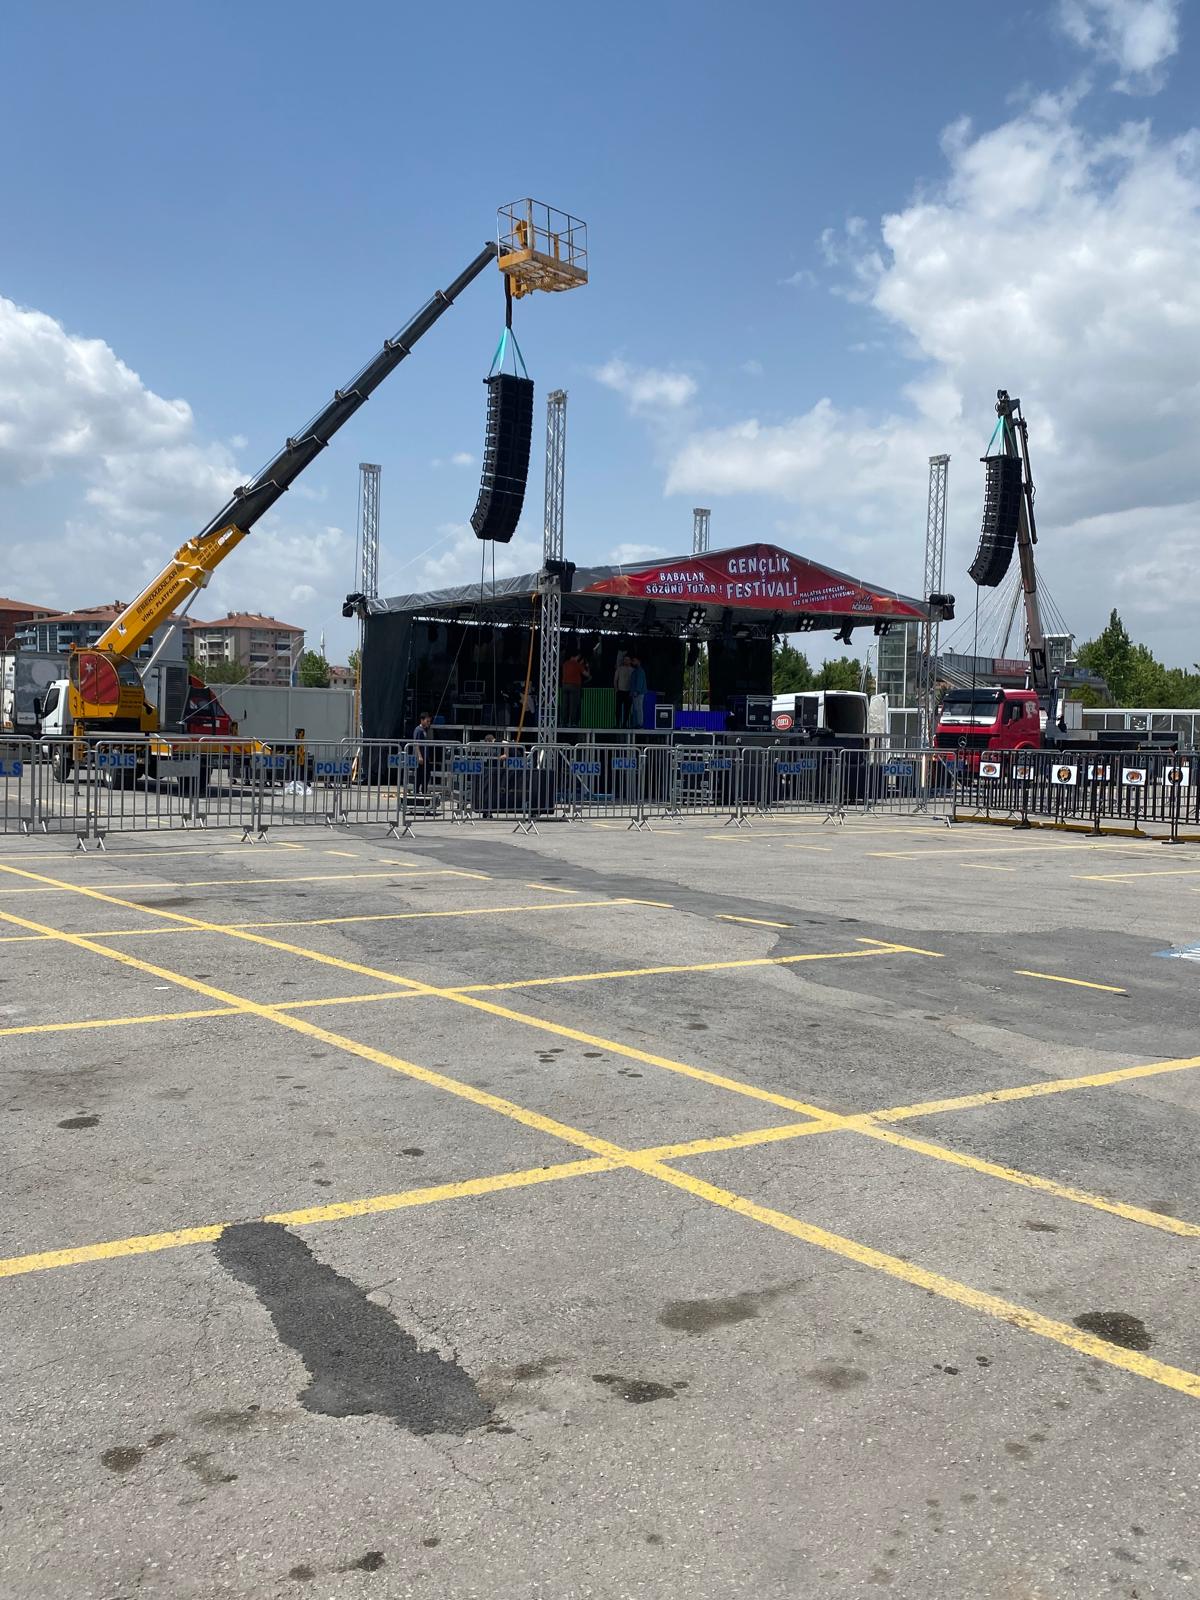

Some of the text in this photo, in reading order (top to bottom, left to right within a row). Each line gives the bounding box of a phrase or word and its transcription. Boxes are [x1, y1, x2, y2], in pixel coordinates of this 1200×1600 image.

[728, 553, 790, 576] GENÇLİK
[645, 582, 683, 594] SÖZÜNÜ
[687, 583, 716, 594] TUTAR
[660, 571, 705, 582] BABALAR
[726, 576, 798, 600] FESTİVALİ
[155, 580, 180, 608] PLATFORM
